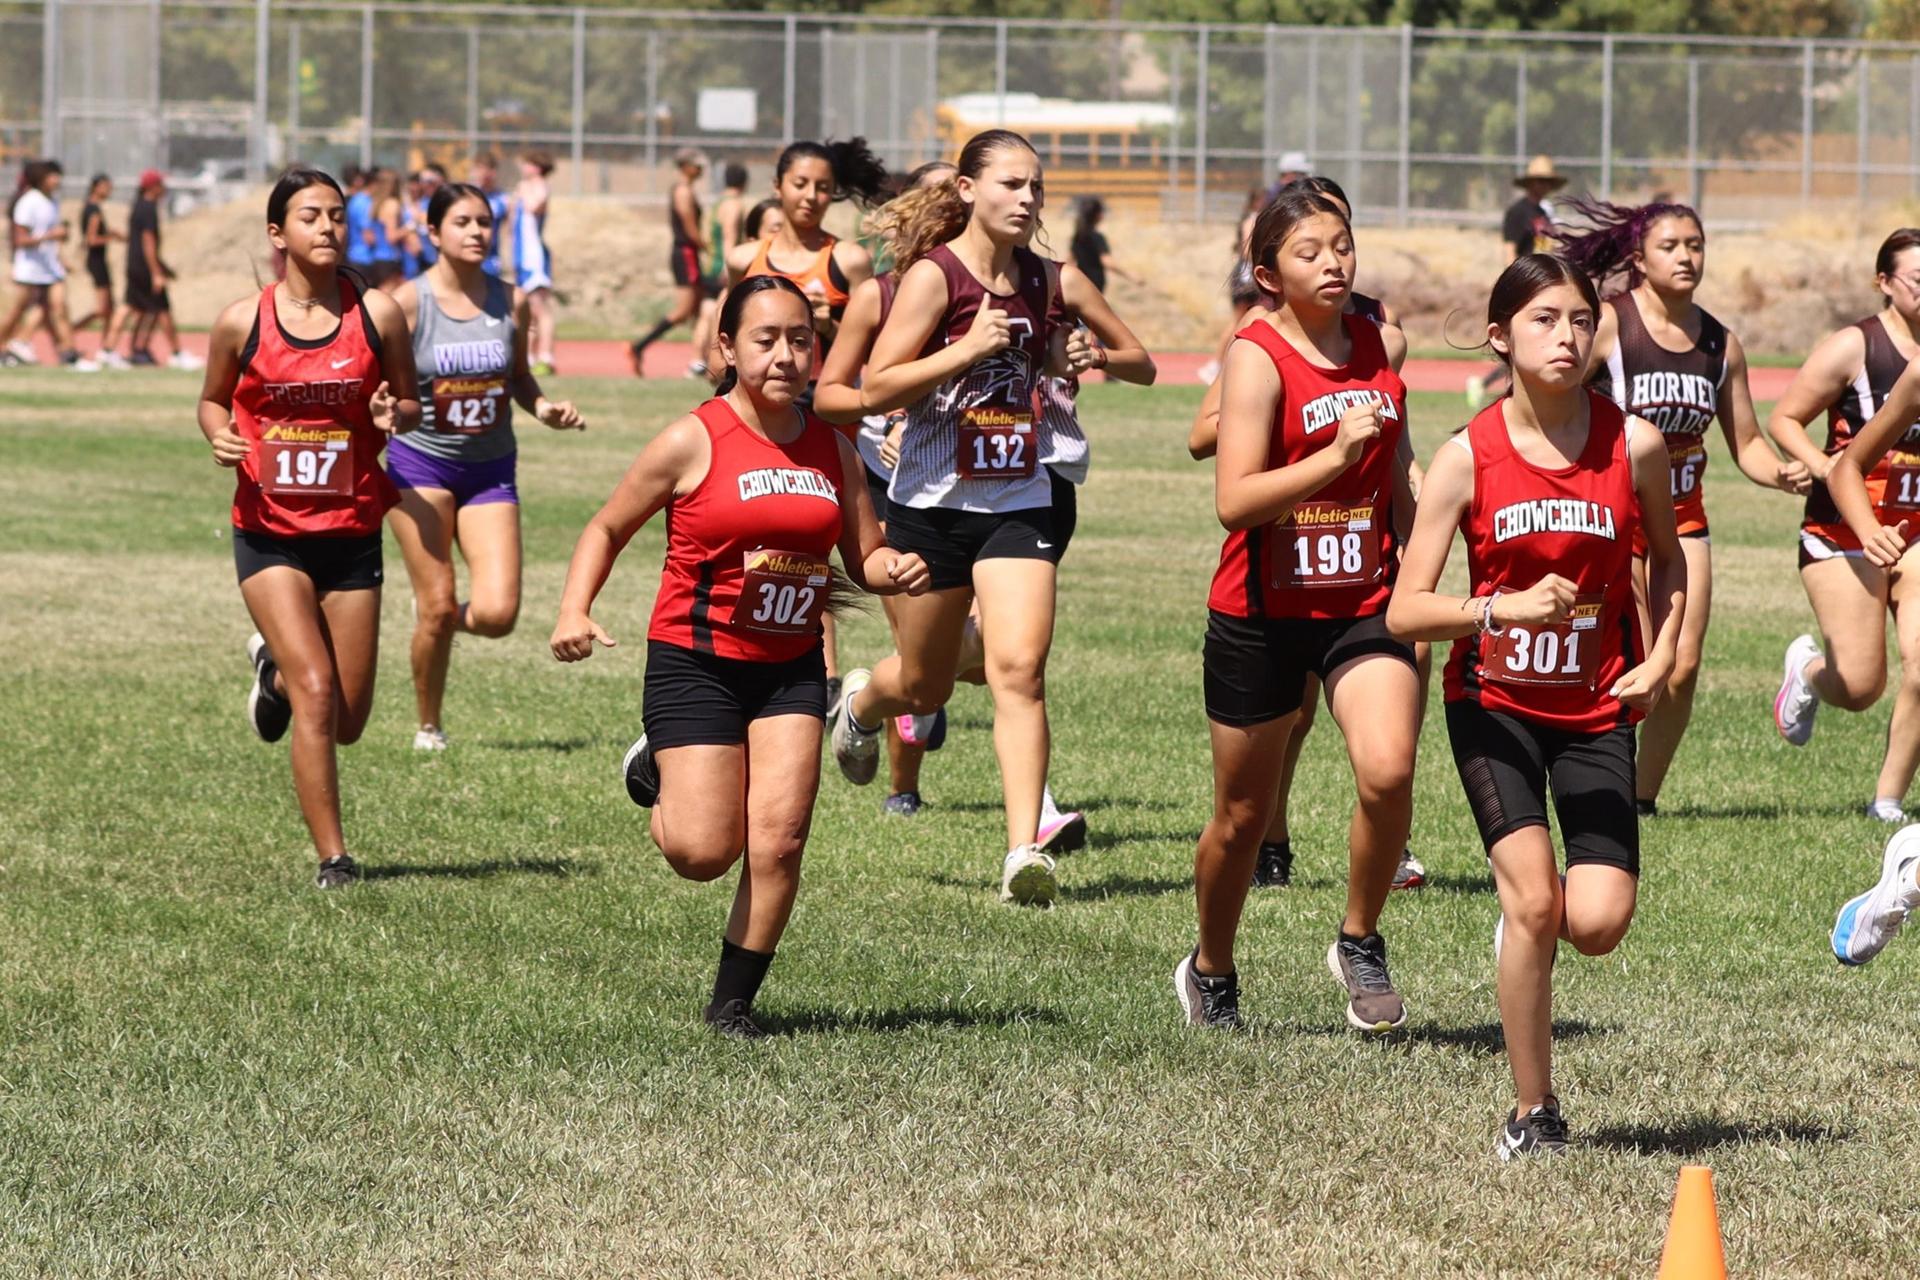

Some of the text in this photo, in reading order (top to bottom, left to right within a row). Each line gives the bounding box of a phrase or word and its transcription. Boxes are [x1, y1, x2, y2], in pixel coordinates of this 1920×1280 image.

[433, 340, 507, 376] WUHS
[264, 379, 364, 405] TRIBE
[446, 397, 496, 427] 423
[263, 425, 328, 441] Athletic
[276, 450, 338, 485] 197
[973, 434, 1025, 469] 132
[738, 468, 840, 507] CHOWCHILLA
[1494, 498, 1616, 544] CHOWCHILLA
[1294, 532, 1362, 576] 198
[752, 582, 816, 625] 302
[1505, 627, 1581, 674] 301
